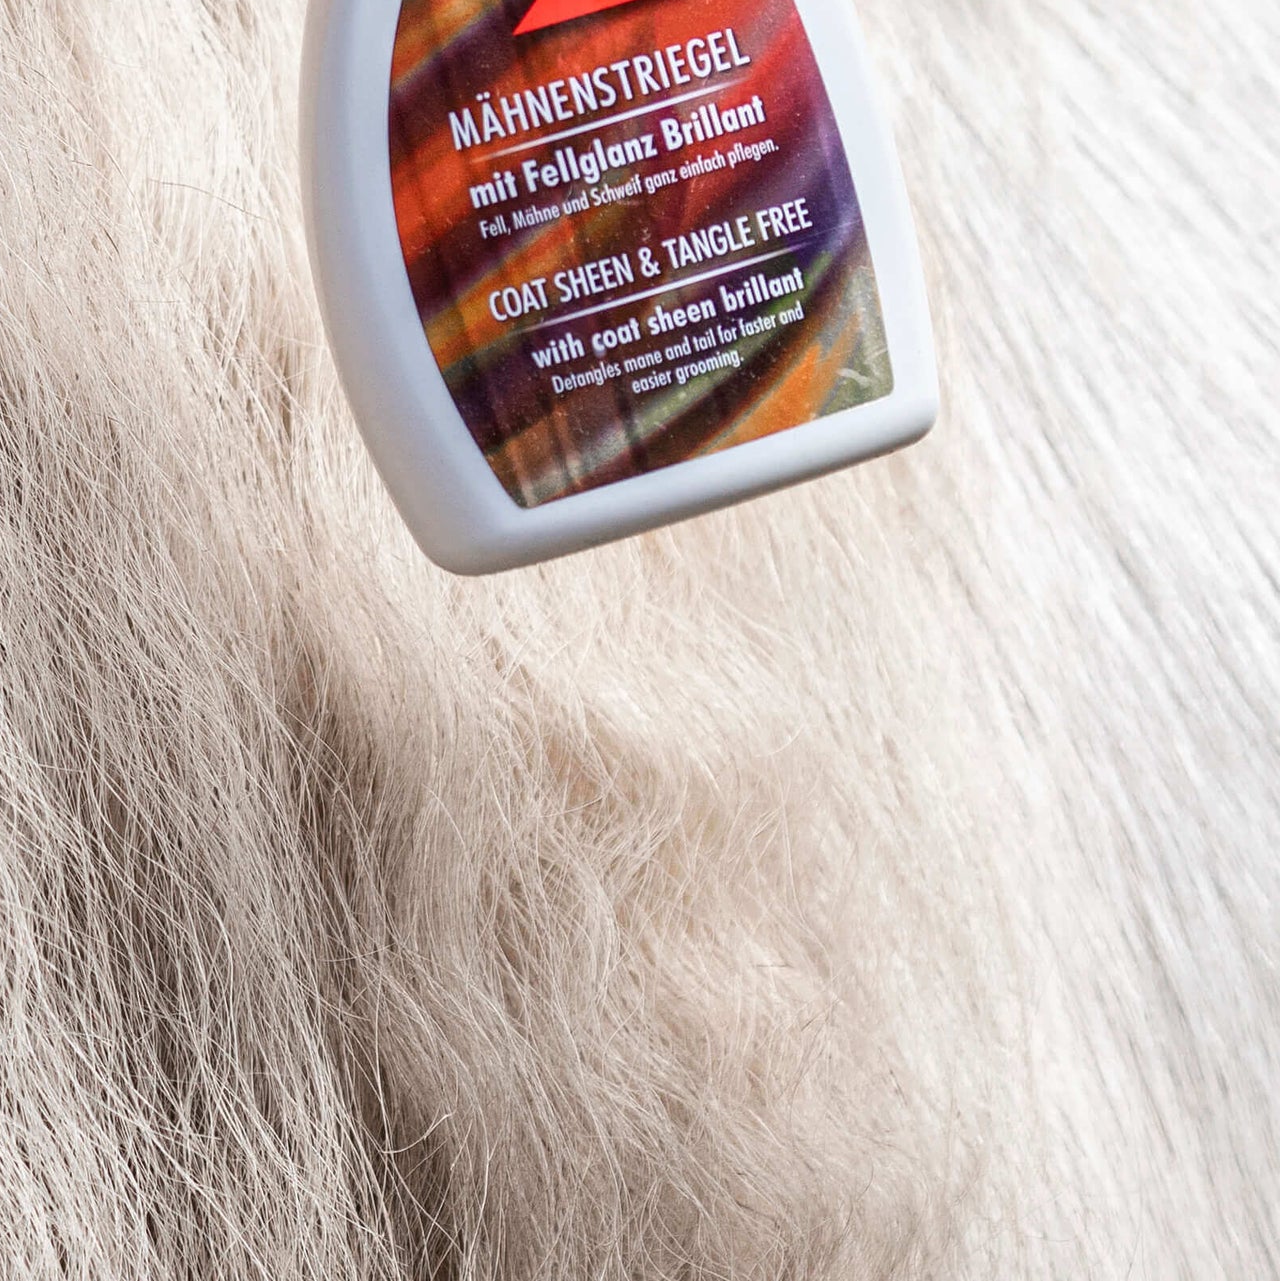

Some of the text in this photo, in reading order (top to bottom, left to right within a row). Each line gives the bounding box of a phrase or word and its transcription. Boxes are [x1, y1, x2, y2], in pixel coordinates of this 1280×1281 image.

[448, 28, 751, 151] MÄHNENSTRIEGEL
[470, 95, 767, 209] mit Fellglanz Brillant
[479, 139, 779, 239] Fell, Mähne und Schweif ganz einfach pflegen.
[489, 198, 814, 322] COAT SHEEN & TANGLE FREE
[532, 266, 805, 369] with coat sheen brillant
[551, 303, 805, 394] Detangles mane and tail for faster and
[632, 348, 745, 394] easier grooming.
